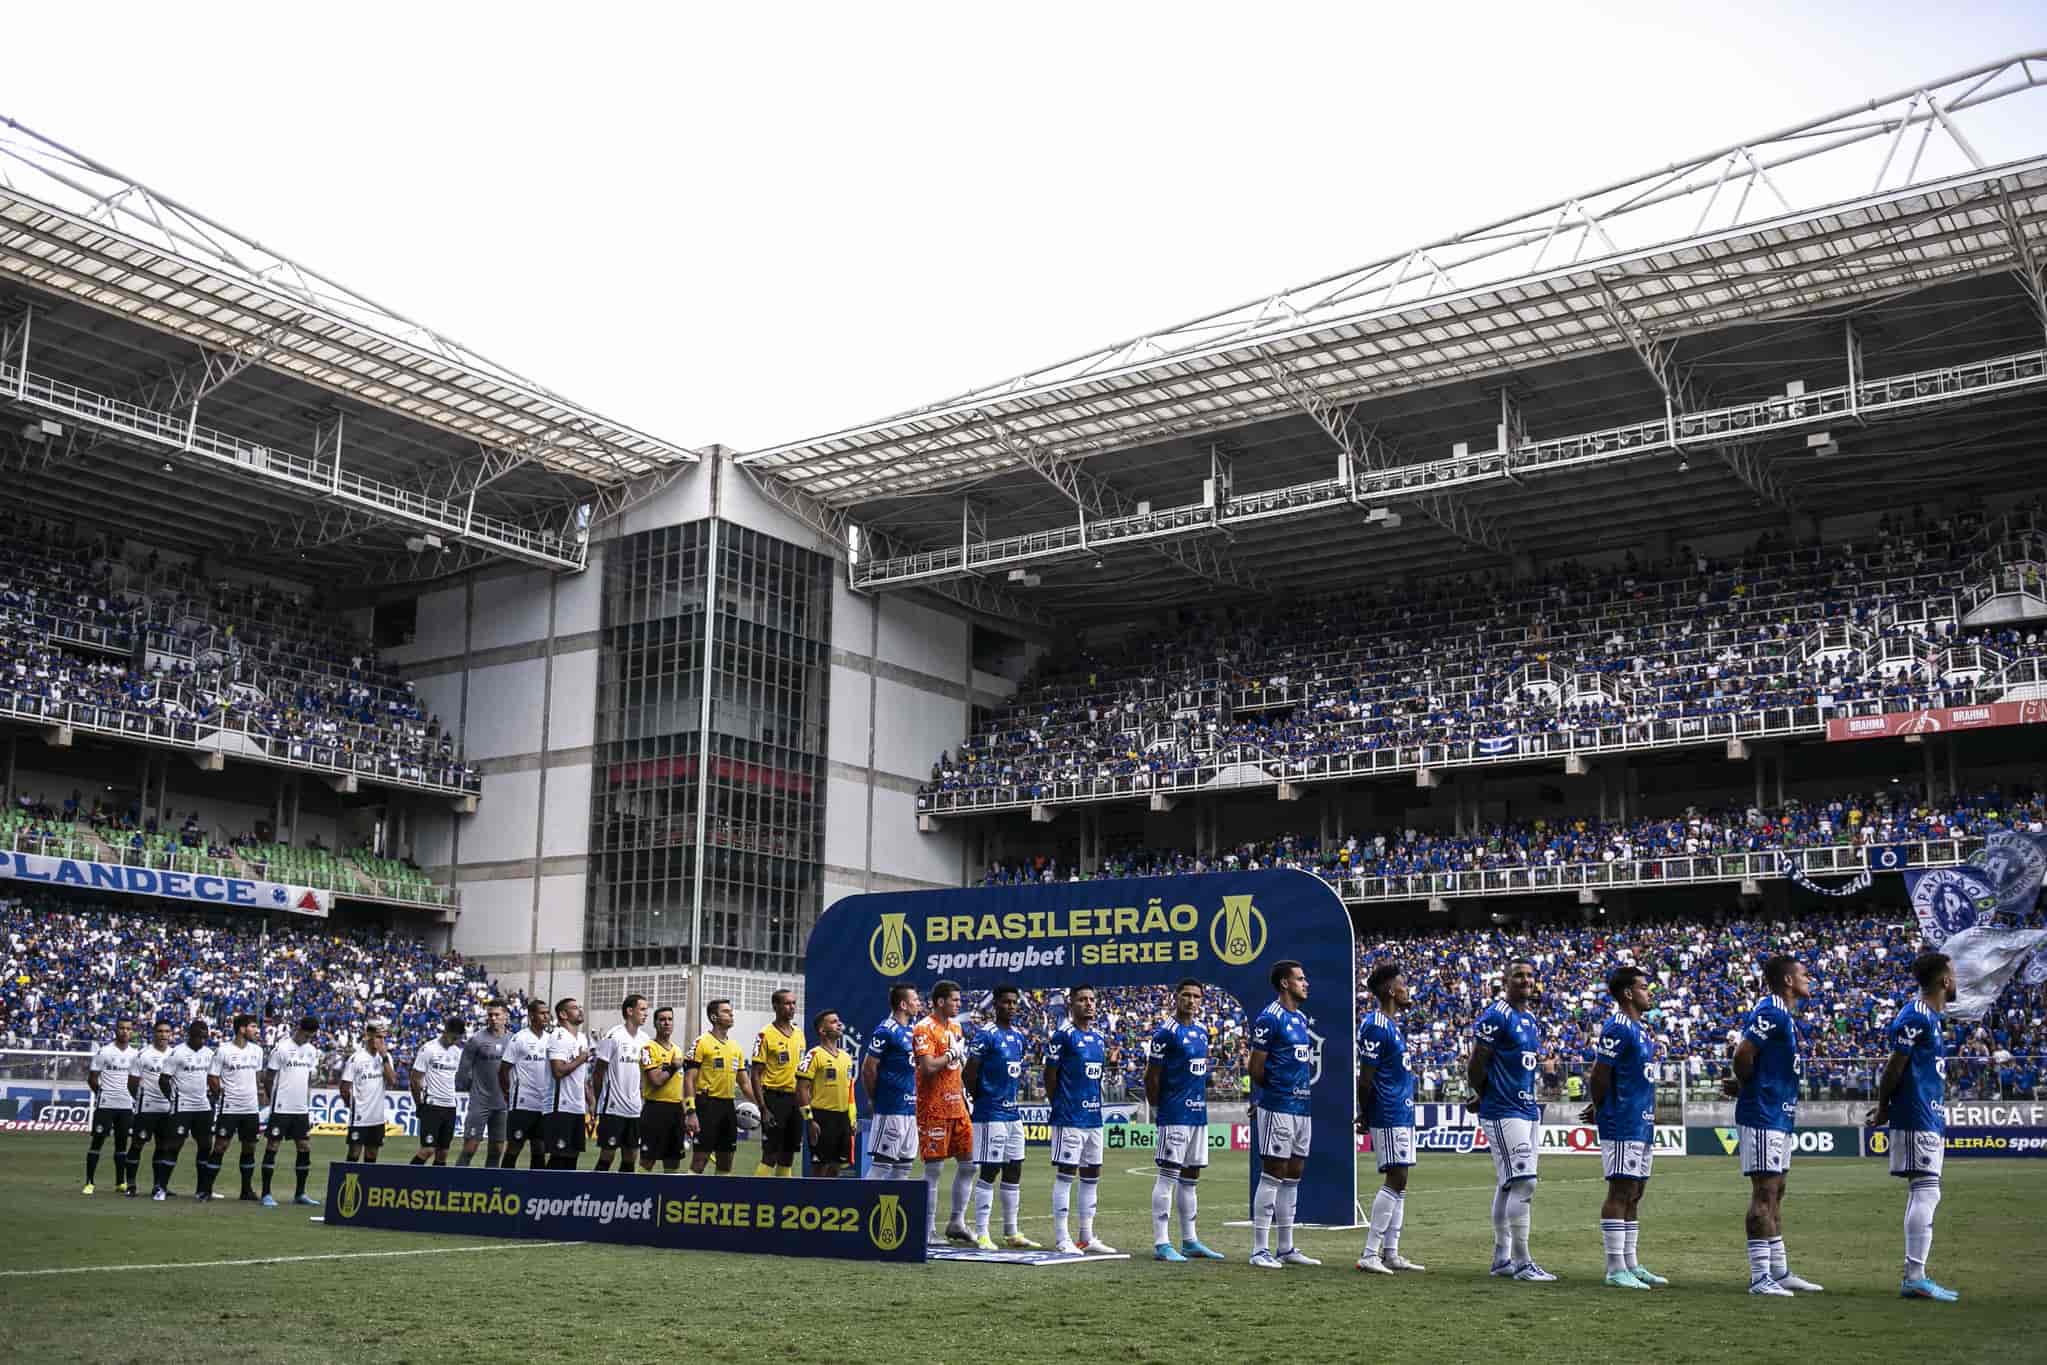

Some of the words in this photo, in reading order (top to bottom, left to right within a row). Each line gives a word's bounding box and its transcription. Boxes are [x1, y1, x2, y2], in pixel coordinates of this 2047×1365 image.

[926, 897, 1199, 942] BRASILEIRÃO
[926, 945, 1065, 974] sportingbet
[1081, 938, 1173, 964] SÉRIE
[1178, 940, 1199, 961] B
[1131, 1130, 1157, 1147] Rei
[367, 1186, 521, 1216] BRASILEIRÃO
[525, 1193, 653, 1225] sportingbet
[665, 1194, 750, 1226] SÉRIE
[756, 1203, 776, 1229] B
[780, 1204, 860, 1233] 2022
